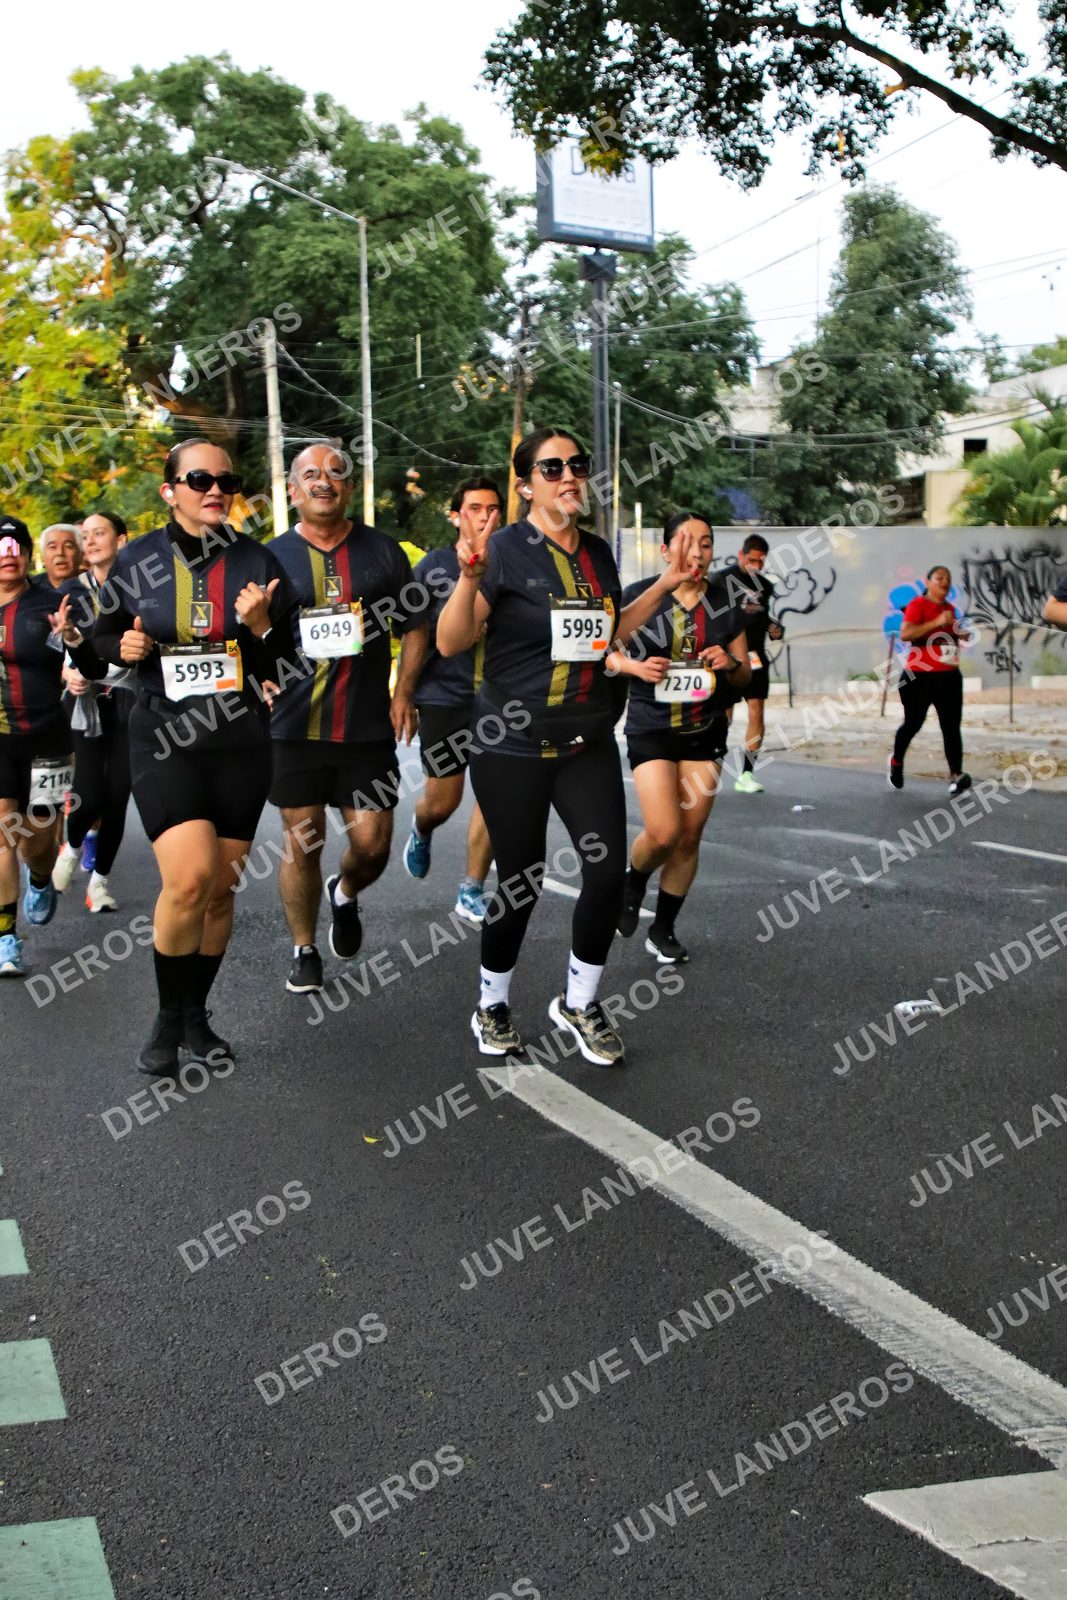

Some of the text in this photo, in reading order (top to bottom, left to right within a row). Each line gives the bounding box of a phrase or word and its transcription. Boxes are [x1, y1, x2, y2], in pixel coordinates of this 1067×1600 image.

[310, 620, 352, 640] 6949
[562, 618, 603, 638] 5995
[175, 660, 224, 682] 5993
[664, 675, 702, 691] 7270
